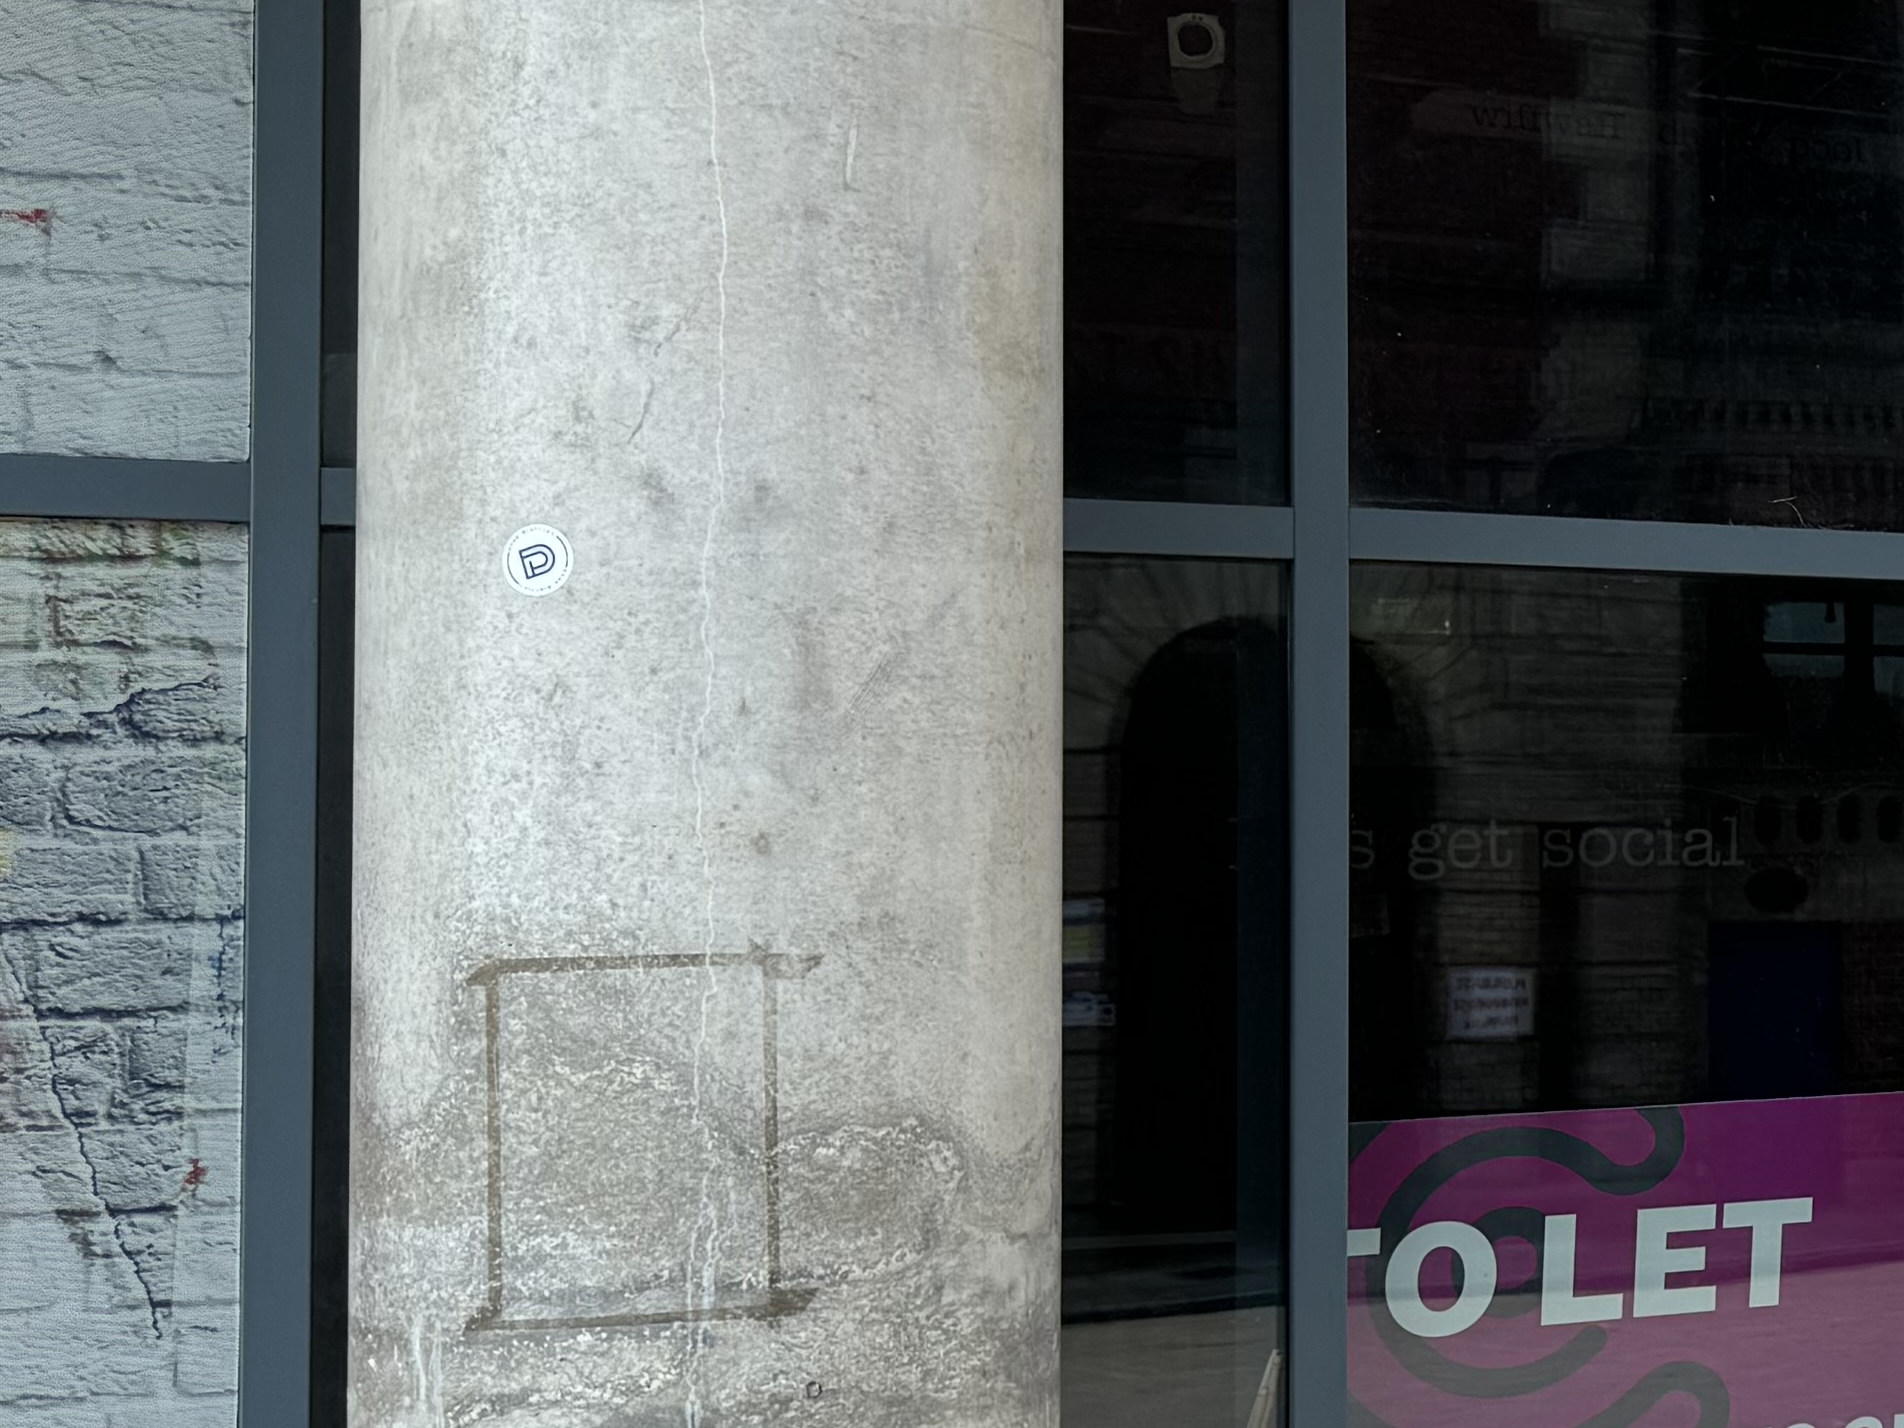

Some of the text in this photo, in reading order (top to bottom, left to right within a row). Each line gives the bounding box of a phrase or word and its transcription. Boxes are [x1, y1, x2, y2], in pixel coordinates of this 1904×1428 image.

[1407, 818, 1514, 881] get
[1541, 815, 1746, 869] social
[1540, 1196, 1813, 1327] LET
